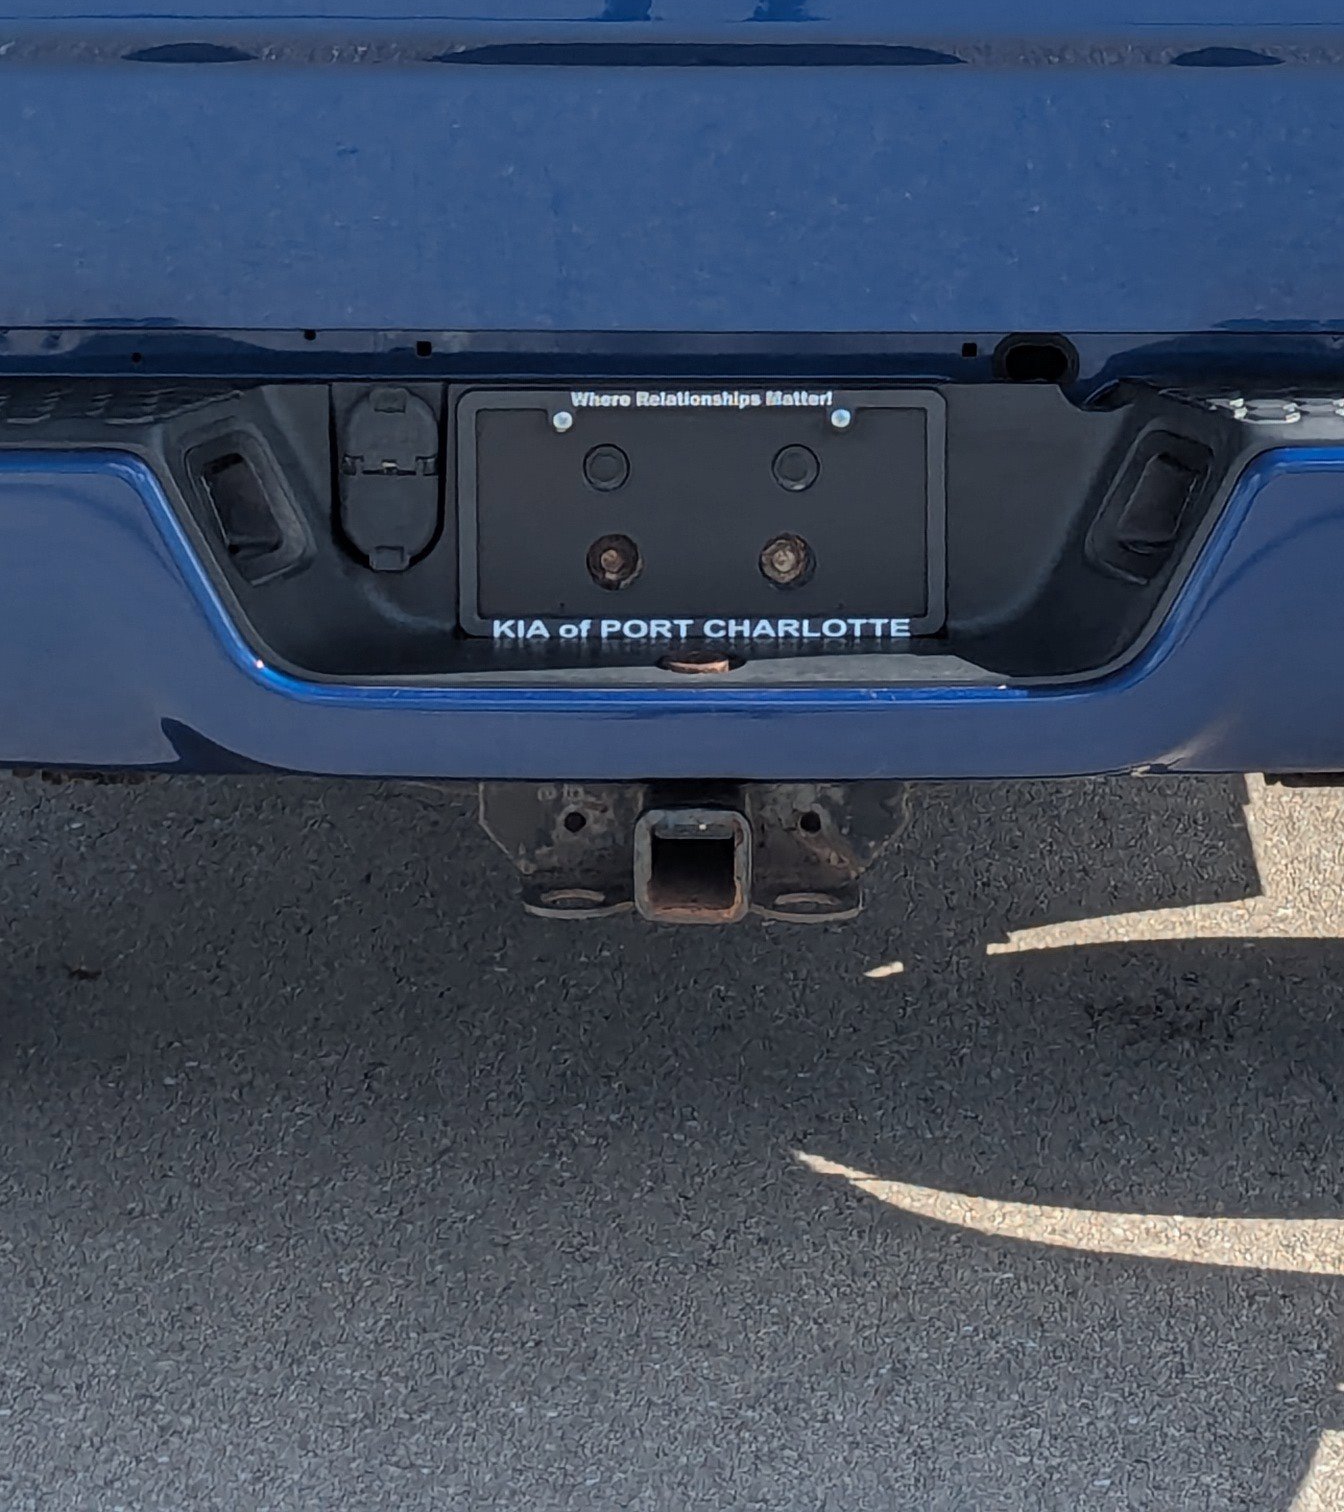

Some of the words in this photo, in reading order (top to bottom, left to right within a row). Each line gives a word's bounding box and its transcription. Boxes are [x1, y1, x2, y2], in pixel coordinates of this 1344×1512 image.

[570, 391, 632, 407] Where
[635, 390, 763, 409] Relationships
[765, 390, 834, 407] Matter!
[493, 619, 550, 639] KIA
[558, 619, 592, 639] of
[600, 619, 694, 639] PORT
[703, 618, 912, 638] CHARLOTTE
